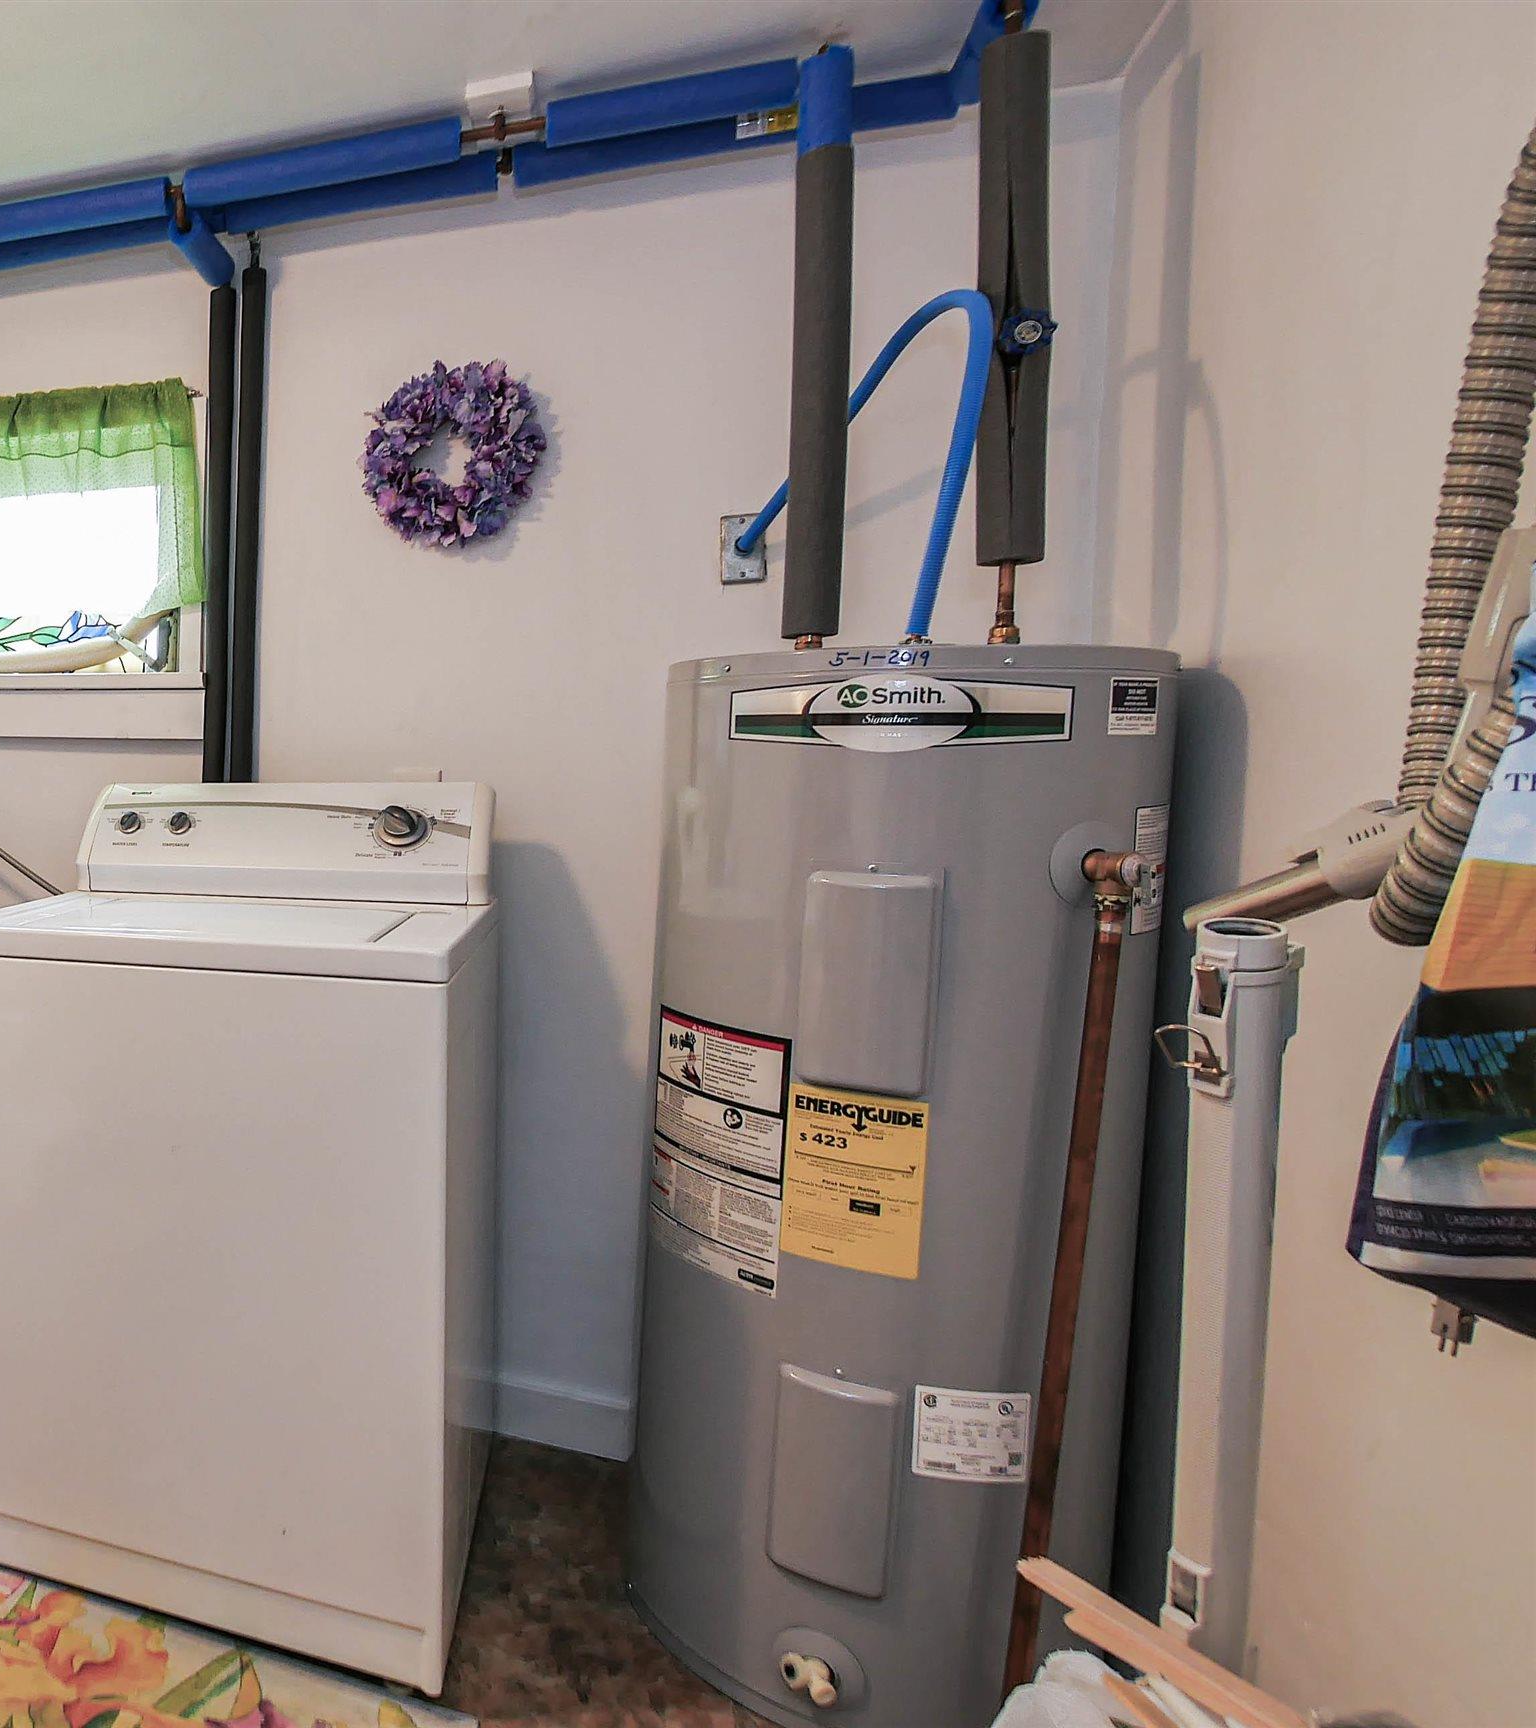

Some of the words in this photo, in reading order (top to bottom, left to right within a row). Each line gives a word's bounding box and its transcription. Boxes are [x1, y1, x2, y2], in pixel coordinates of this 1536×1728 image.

[829, 650, 930, 667] 5-1-2019
[862, 713, 919, 725] Signature
[698, 1025, 724, 1038] DANGER
[811, 1132, 848, 1150] 423
